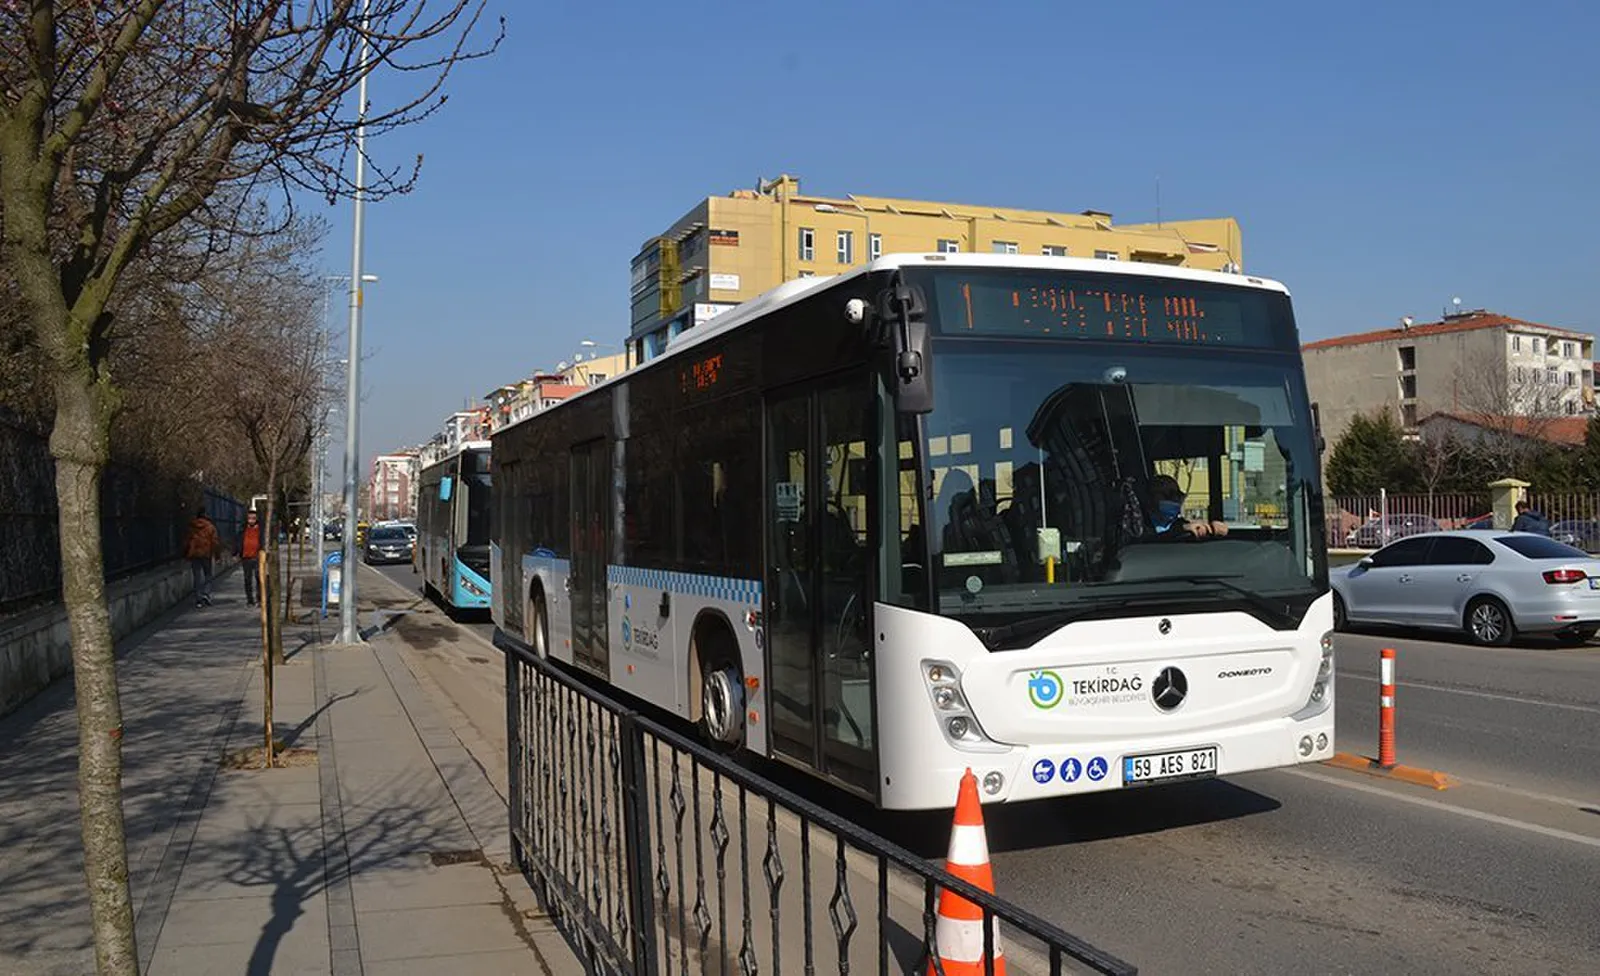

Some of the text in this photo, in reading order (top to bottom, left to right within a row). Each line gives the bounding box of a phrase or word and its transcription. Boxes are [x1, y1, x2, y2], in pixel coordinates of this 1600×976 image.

[1073, 673, 1143, 695] TEKİRDAĞ
[1135, 752, 1213, 778] 59 AES 821
